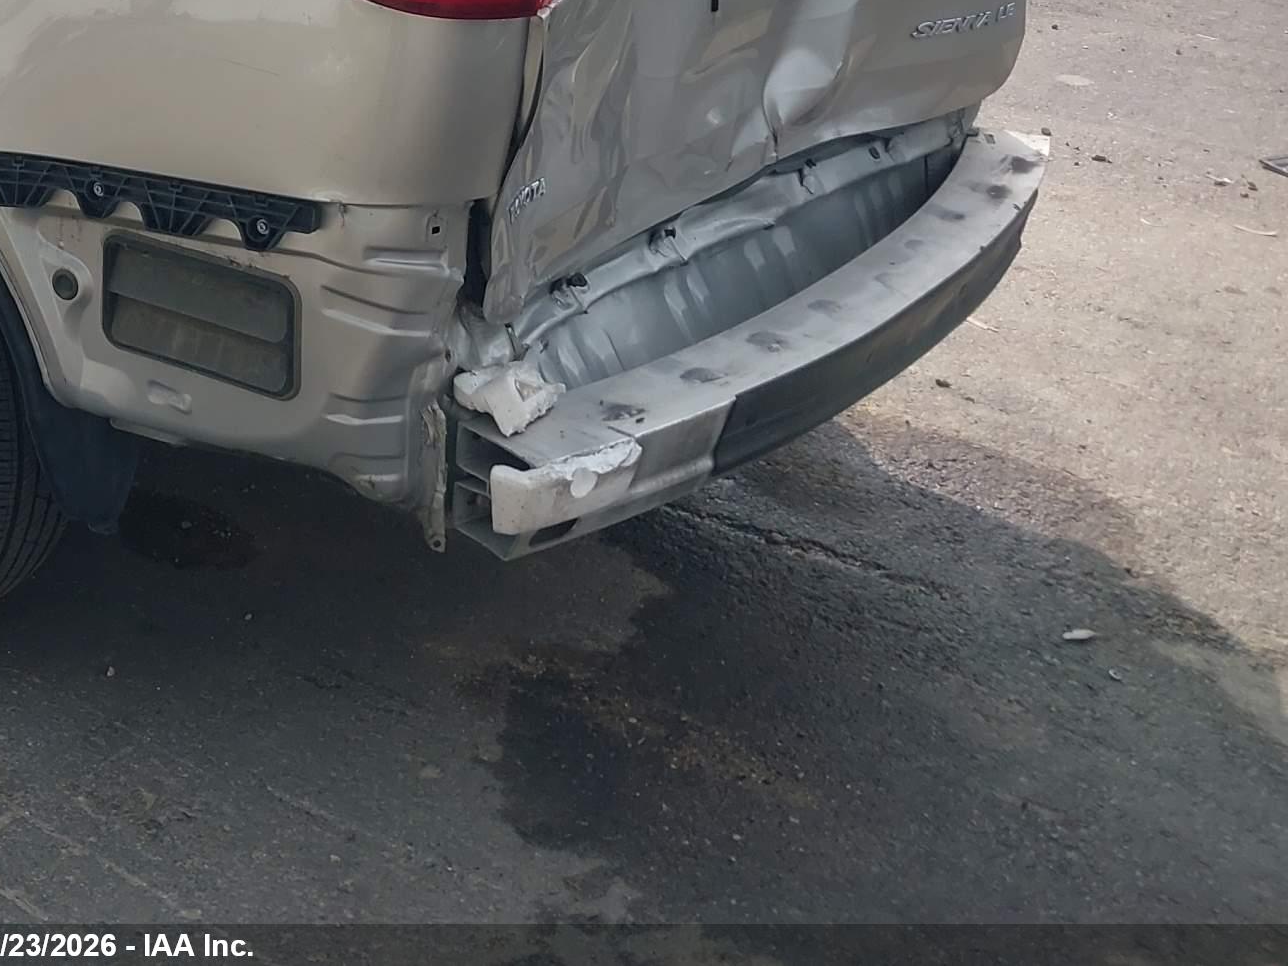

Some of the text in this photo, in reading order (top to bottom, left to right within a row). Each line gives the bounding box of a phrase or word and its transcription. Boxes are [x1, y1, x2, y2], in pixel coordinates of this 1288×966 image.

[910, 1, 1016, 39] SIENNA LE
[506, 177, 546, 224] TOYOTA
